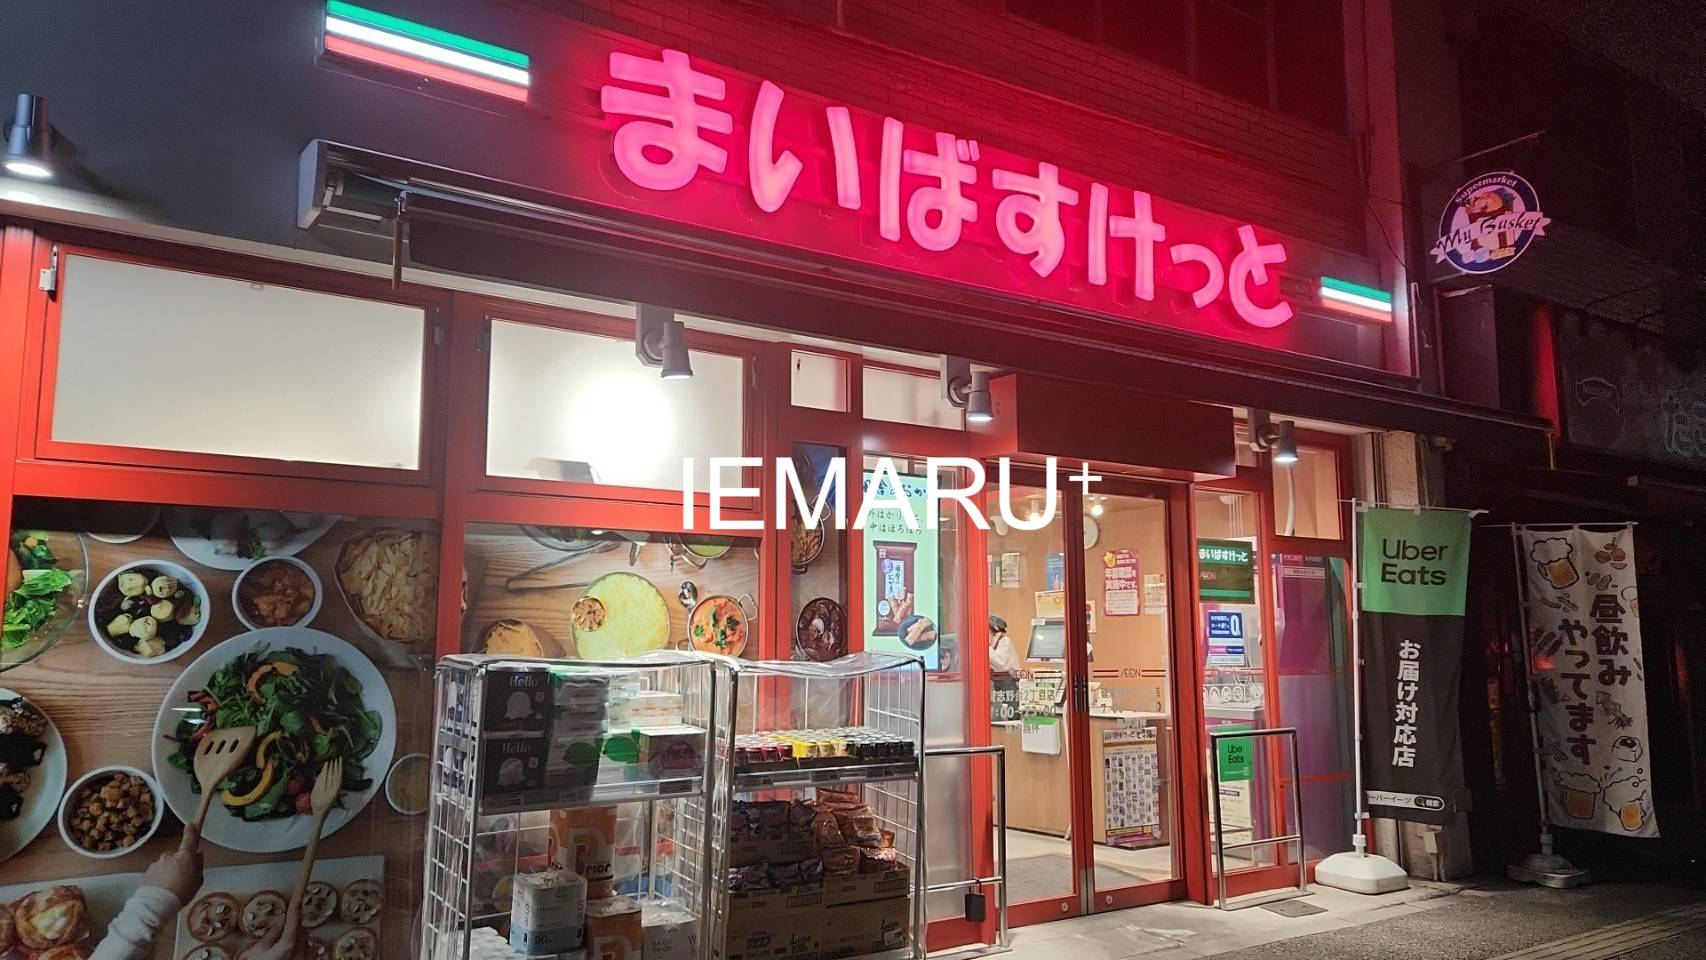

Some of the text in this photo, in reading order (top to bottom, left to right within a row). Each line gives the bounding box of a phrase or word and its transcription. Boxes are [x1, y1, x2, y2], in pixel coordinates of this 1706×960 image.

[601, 49, 1293, 328] まいばすけっと
[1456, 175, 1518, 204] Supermarket
[1436, 228, 1472, 253] My
[1382, 538, 1449, 561] Uber
[1381, 562, 1447, 586] Eats
[1590, 593, 1633, 687] 昼飲み
[510, 675, 537, 689] Hello
[1558, 617, 1598, 766] やってます
[1391, 639, 1422, 768] お届け対応店
[1227, 744, 1243, 754] Uber
[1228, 755, 1245, 765] Eats
